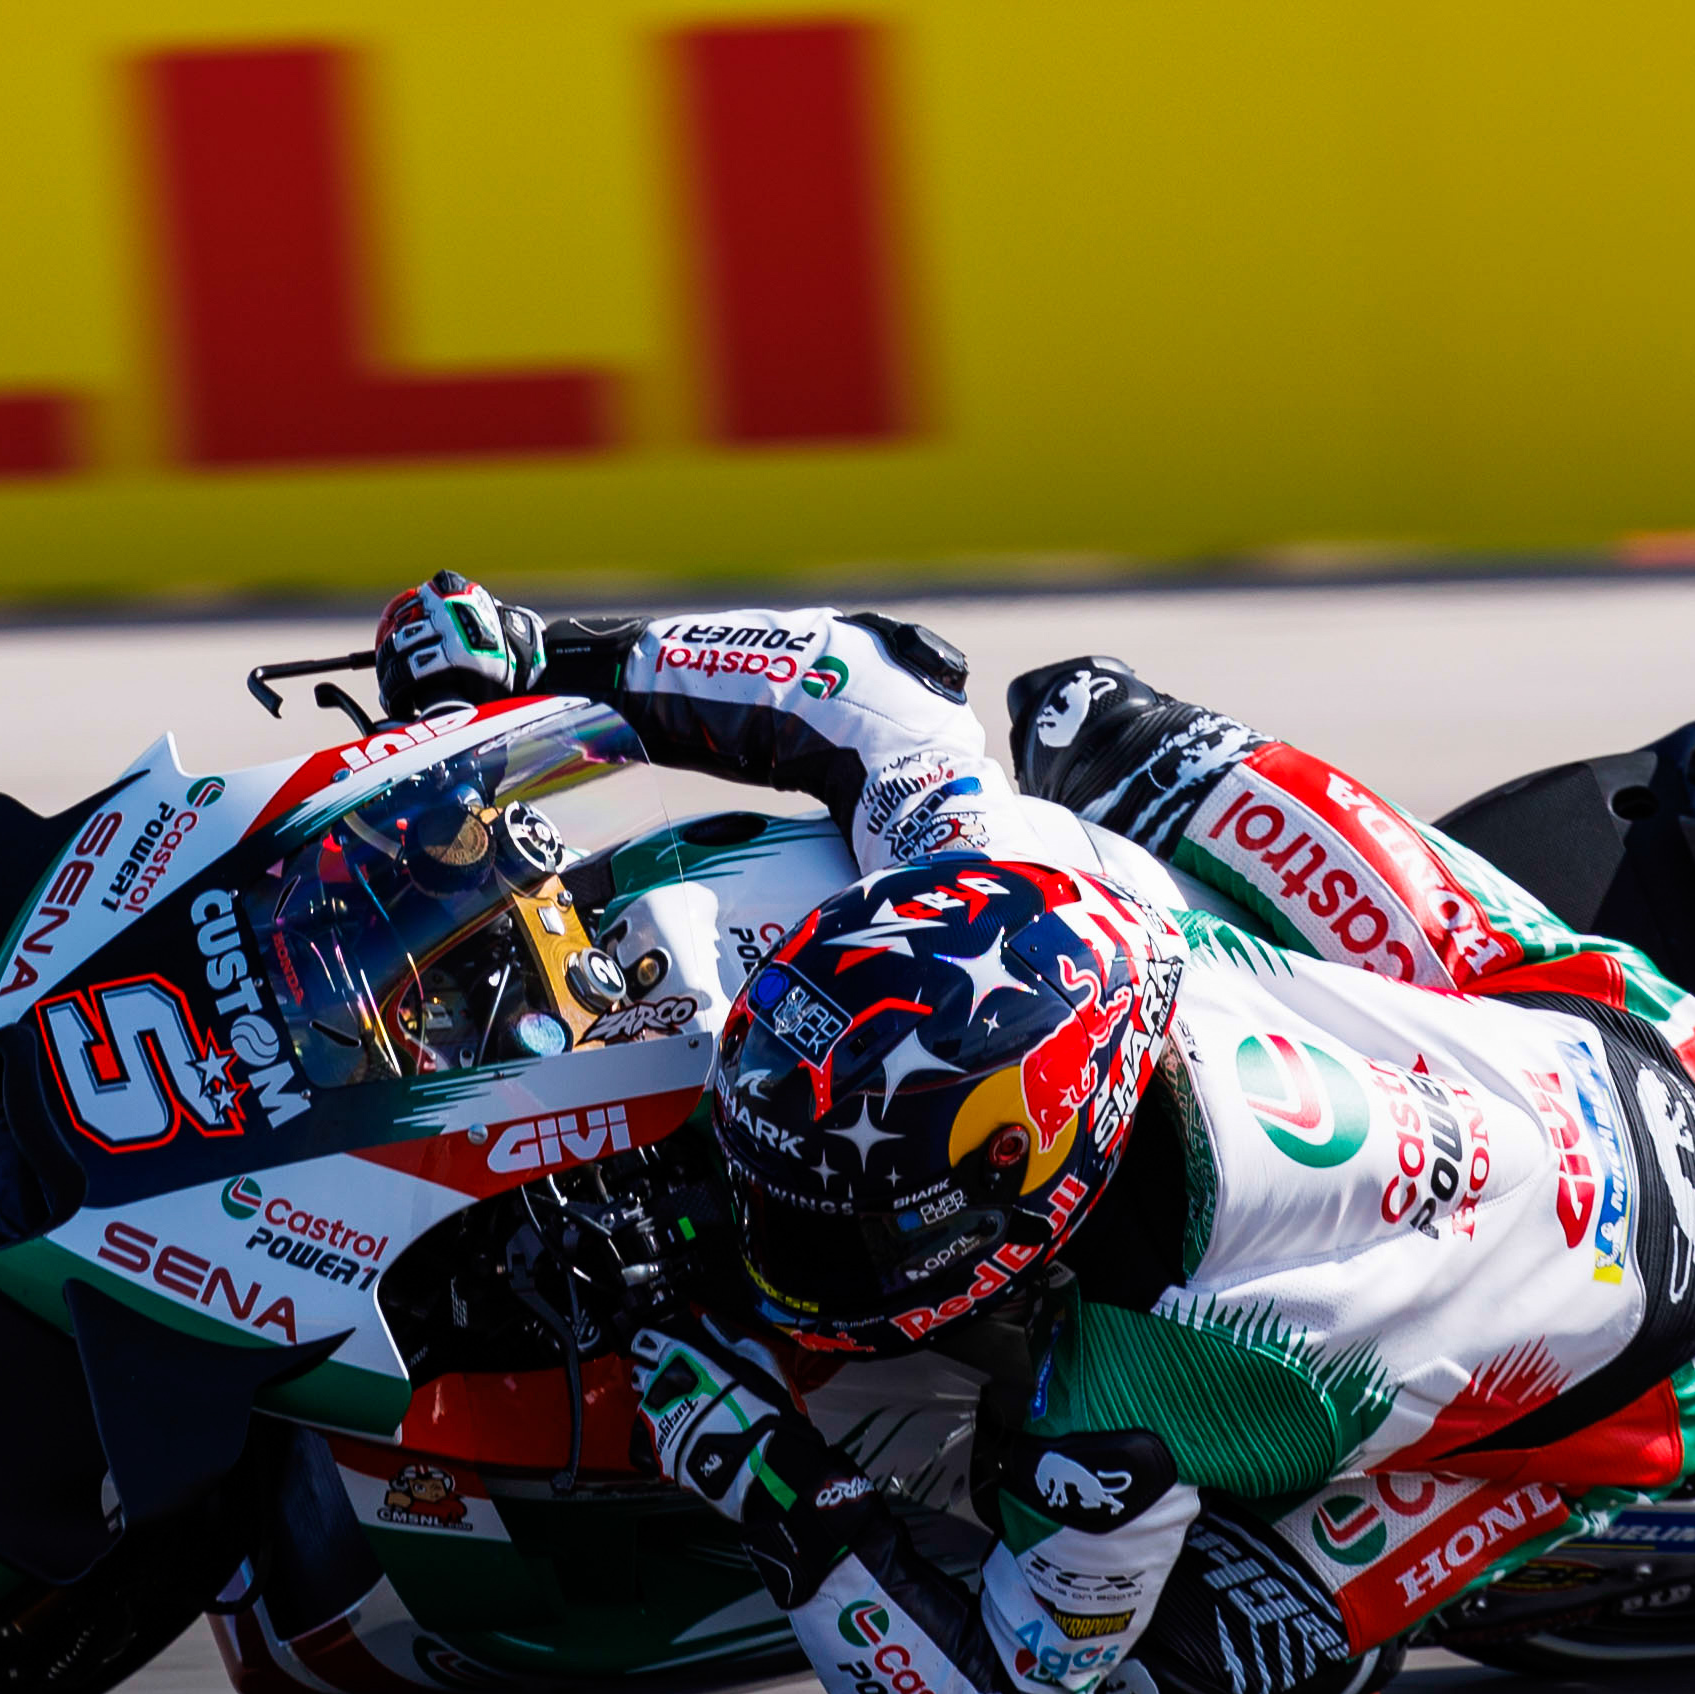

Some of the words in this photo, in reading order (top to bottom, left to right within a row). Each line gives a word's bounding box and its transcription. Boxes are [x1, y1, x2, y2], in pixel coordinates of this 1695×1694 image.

[656, 645, 798, 685] Castrol
[339, 703, 479, 776] GIVI
[101, 802, 176, 913] POWER1
[123, 811, 198, 915] Castrol
[1326, 773, 1506, 977] HONDA
[39, 976, 238, 1150] 5
[486, 1103, 632, 1175] GIVI
[264, 1196, 389, 1263] Castrol
[892, 1176, 952, 1211] SHARK
[97, 1221, 299, 1346] SENA
[245, 1225, 382, 1293] POWER1
[890, 1260, 1008, 1343] Red
